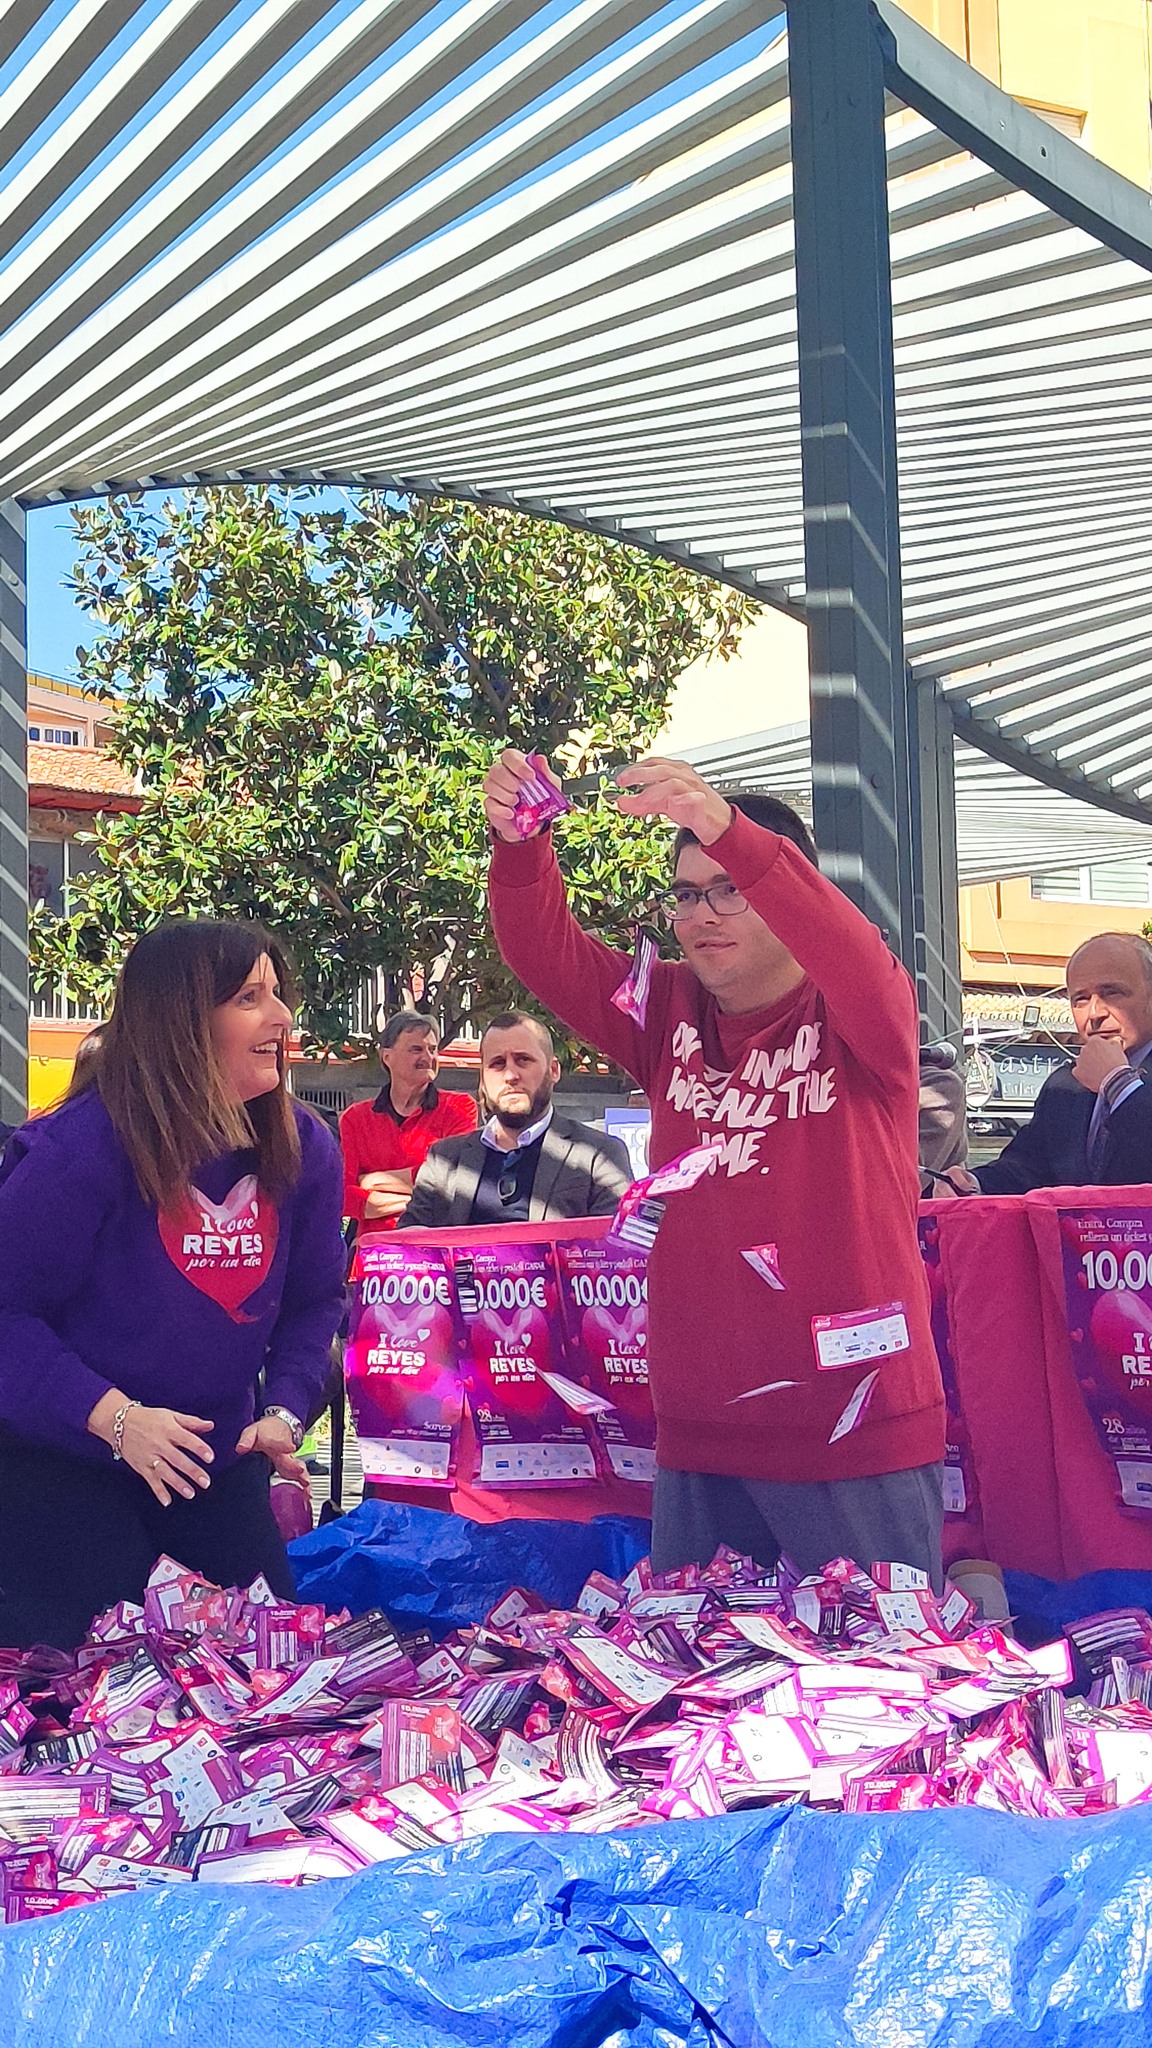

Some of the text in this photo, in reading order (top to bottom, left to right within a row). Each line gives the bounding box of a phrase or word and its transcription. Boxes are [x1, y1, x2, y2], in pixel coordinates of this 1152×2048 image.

[999, 1054, 1073, 1075] astr
[711, 1087, 778, 1128] ALL
[777, 1067, 837, 1119] THE
[1106, 1218, 1143, 1231] Compra
[182, 1233, 263, 1256] REYES
[1111, 1234, 1122, 1242] un
[185, 1257, 215, 1271] por
[220, 1257, 238, 1268] un
[1082, 1250, 1152, 1291] 10.0
[362, 1274, 452, 1305] 10.000€
[367, 1349, 426, 1367] REYES
[489, 1357, 536, 1374] REYES
[603, 1357, 649, 1374] REYES
[1101, 1418, 1125, 1434] 28
